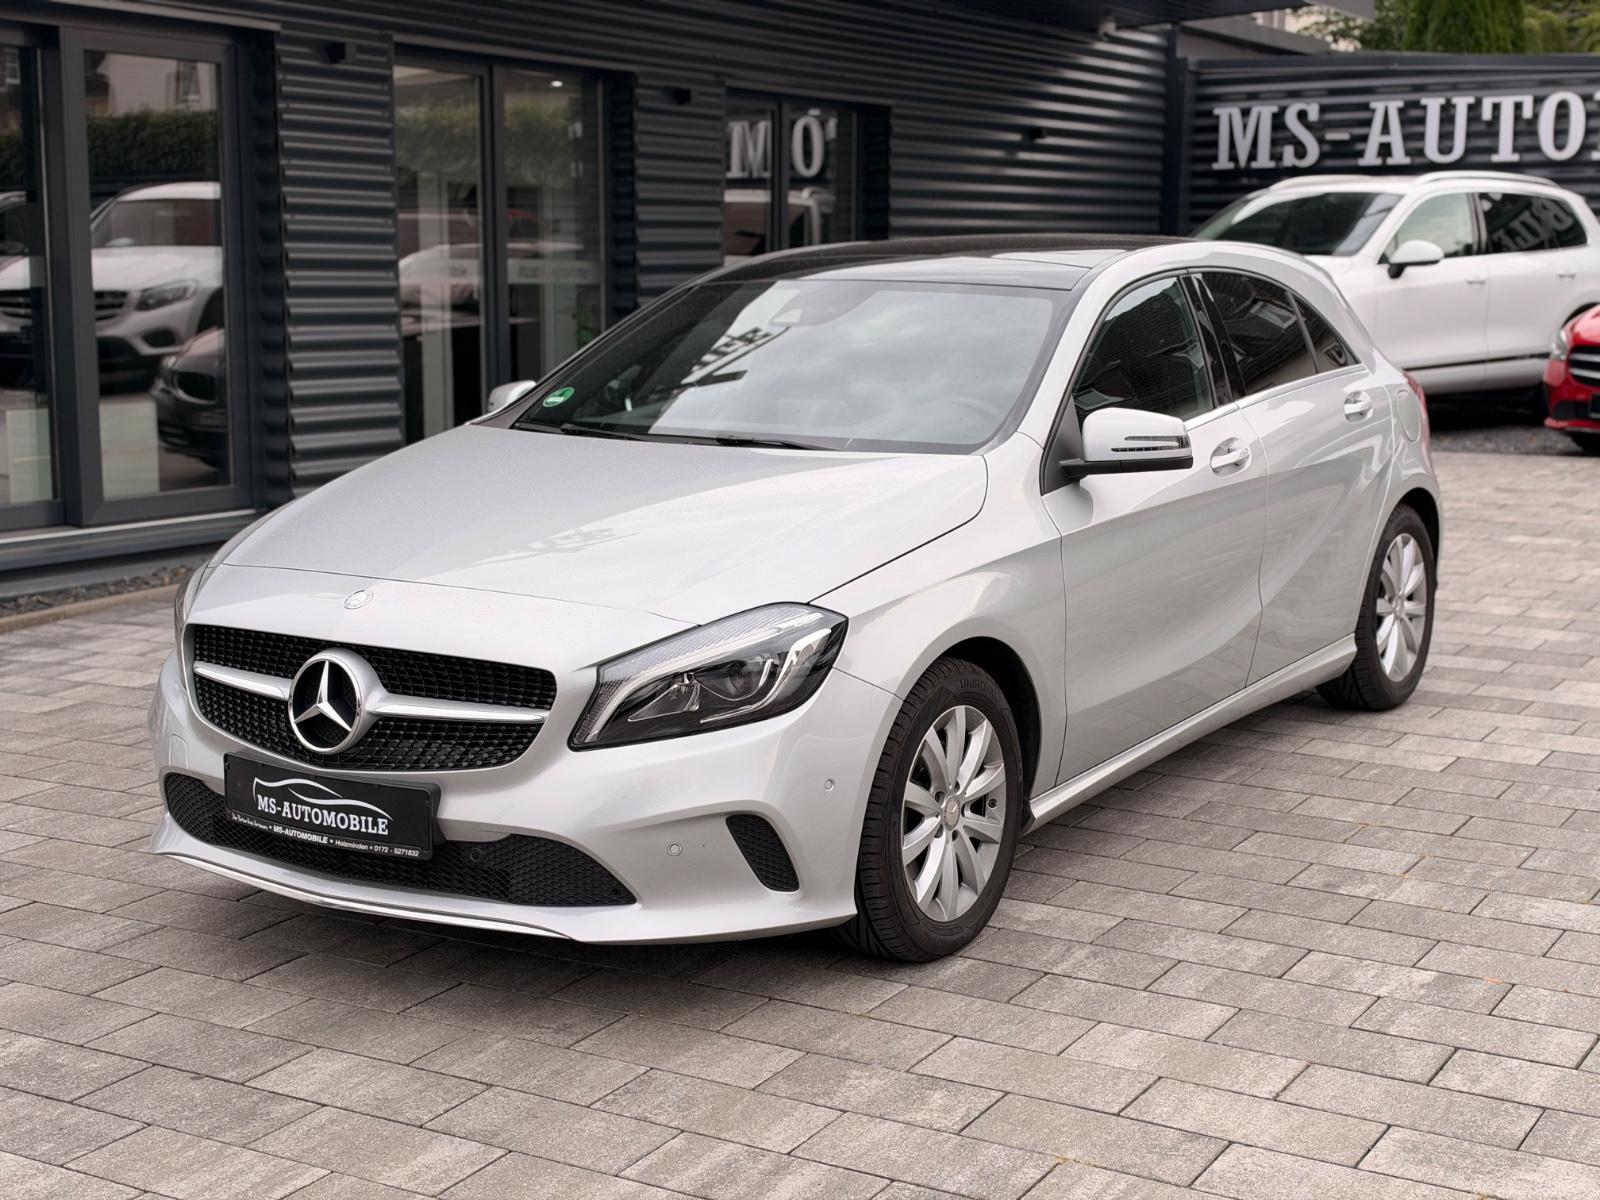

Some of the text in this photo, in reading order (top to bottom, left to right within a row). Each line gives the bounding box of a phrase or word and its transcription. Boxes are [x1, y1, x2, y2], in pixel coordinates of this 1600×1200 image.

[1212, 90, 1600, 169] MS-AUTO
[257, 794, 389, 835] MS-AUTOMOBILE
[273, 825, 328, 844] MS-AUTOMOBILE
[335, 839, 368, 850] Holzminden
[374, 846, 389, 854] 0172
[394, 847, 419, 857] 5271832
